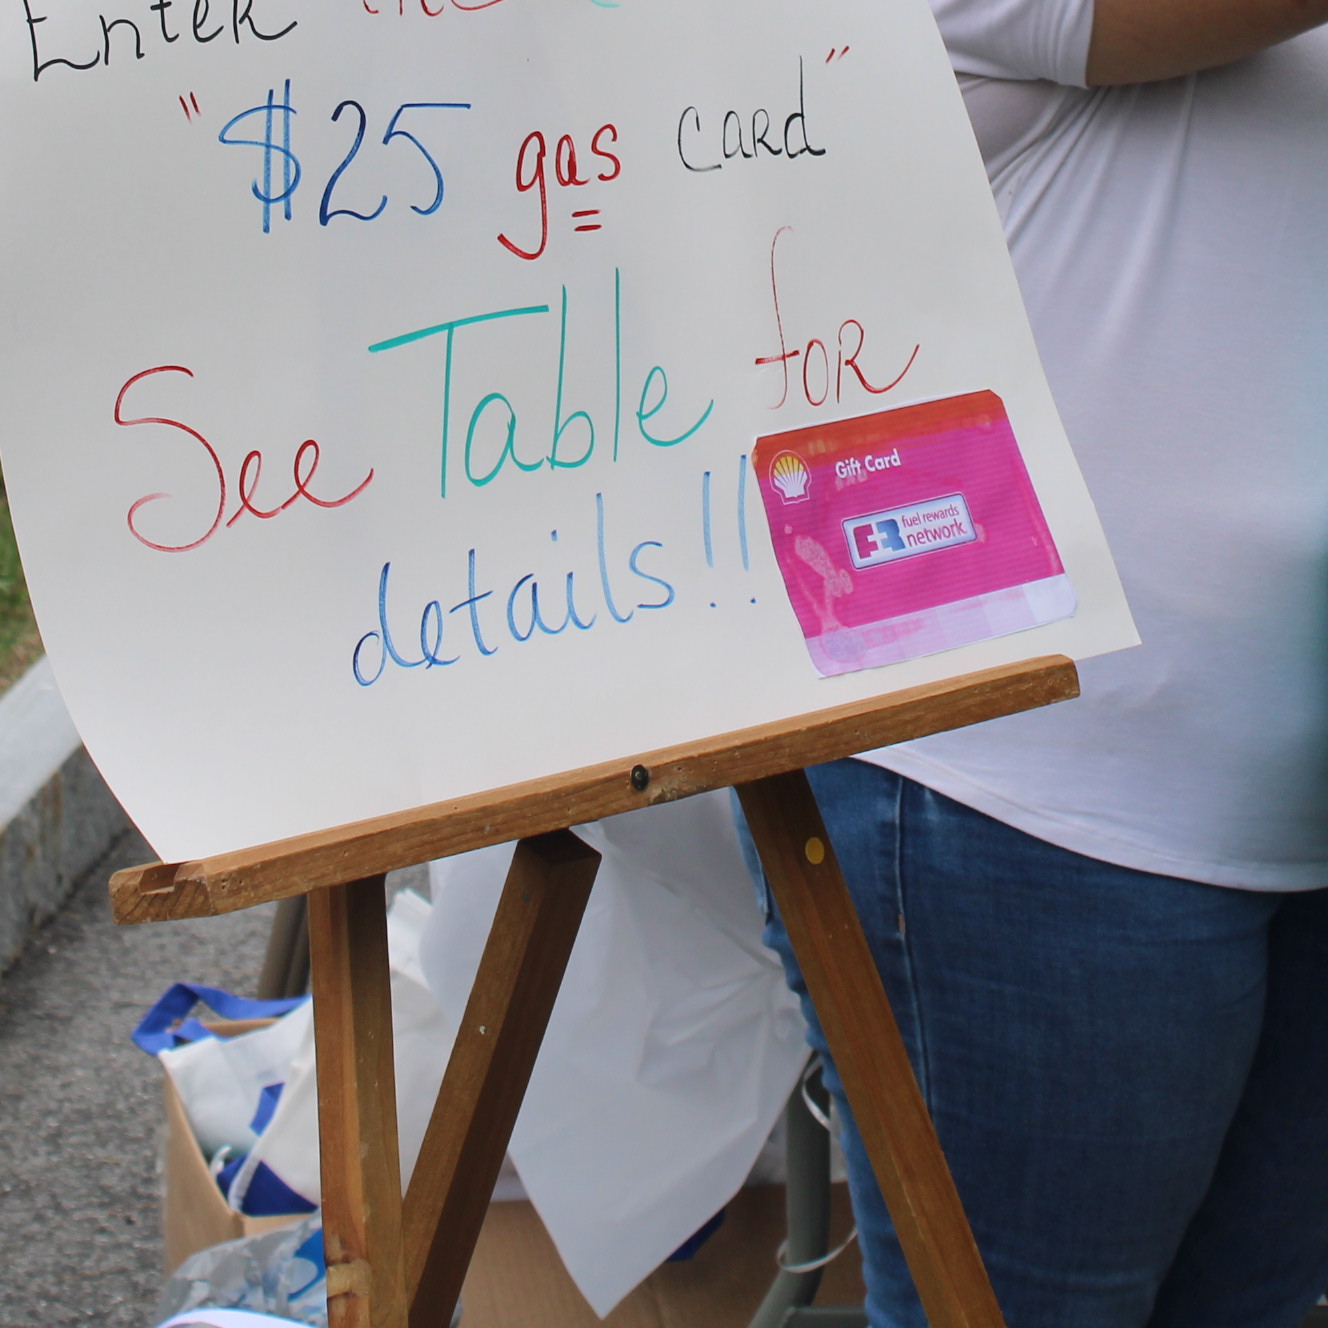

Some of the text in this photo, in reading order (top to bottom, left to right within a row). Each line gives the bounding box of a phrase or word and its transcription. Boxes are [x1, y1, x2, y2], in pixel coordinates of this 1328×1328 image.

[497, 120, 622, 260] gas
[113, 364, 375, 553] See
[368, 267, 714, 498] Table
[835, 448, 902, 479] Gift Card
[352, 454, 759, 687] details!!
[901, 512, 921, 528] fuel
[922, 503, 960, 524] rewards
